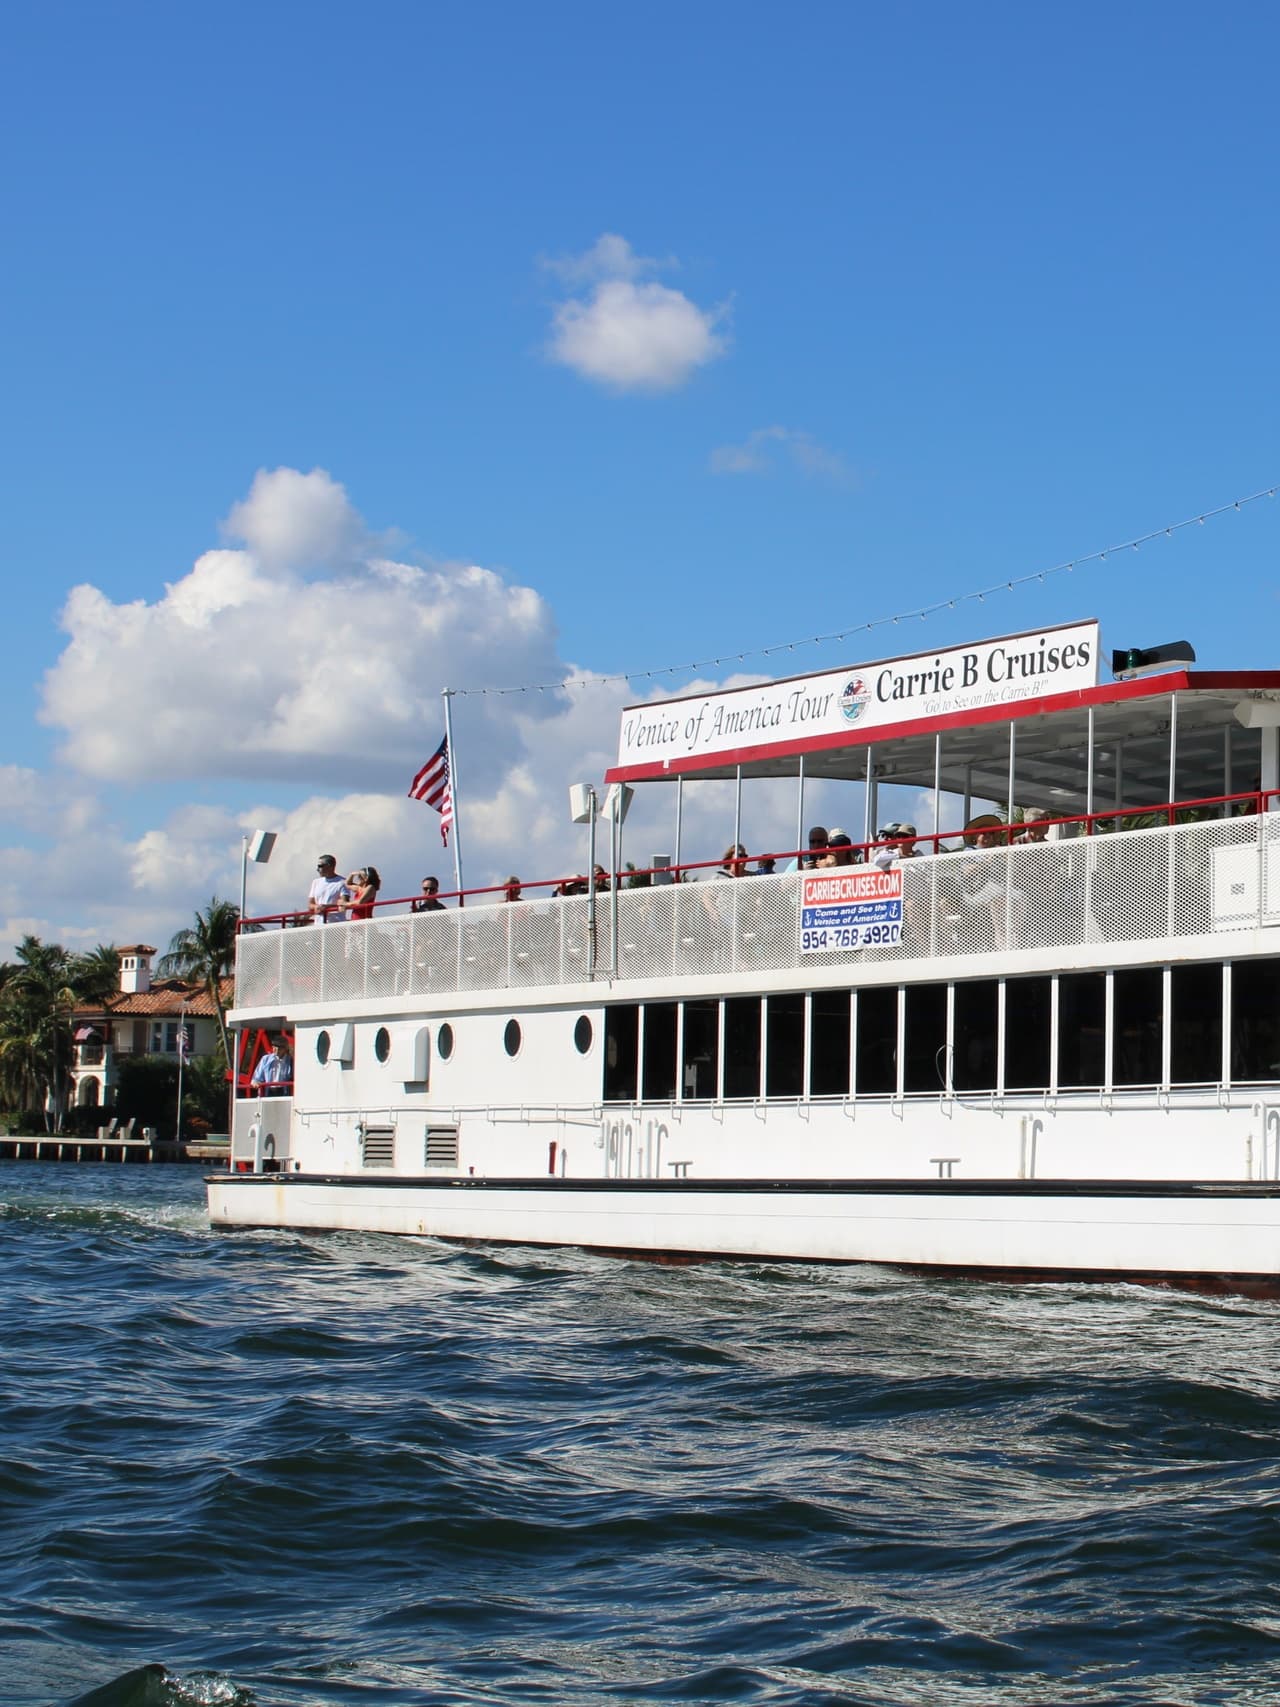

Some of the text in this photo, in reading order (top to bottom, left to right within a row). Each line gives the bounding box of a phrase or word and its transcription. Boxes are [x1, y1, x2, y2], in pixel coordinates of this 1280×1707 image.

[877, 638, 1090, 702] Carrie B Cruises
[970, 694, 982, 705] on
[984, 689, 999, 702] the
[1001, 685, 1030, 701] Carrie
[624, 686, 834, 750] Venice of America Tour
[805, 873, 900, 902] CARRIEBCRUISES.COM
[814, 917, 840, 926] Venice
[815, 904, 887, 917] Come and See the
